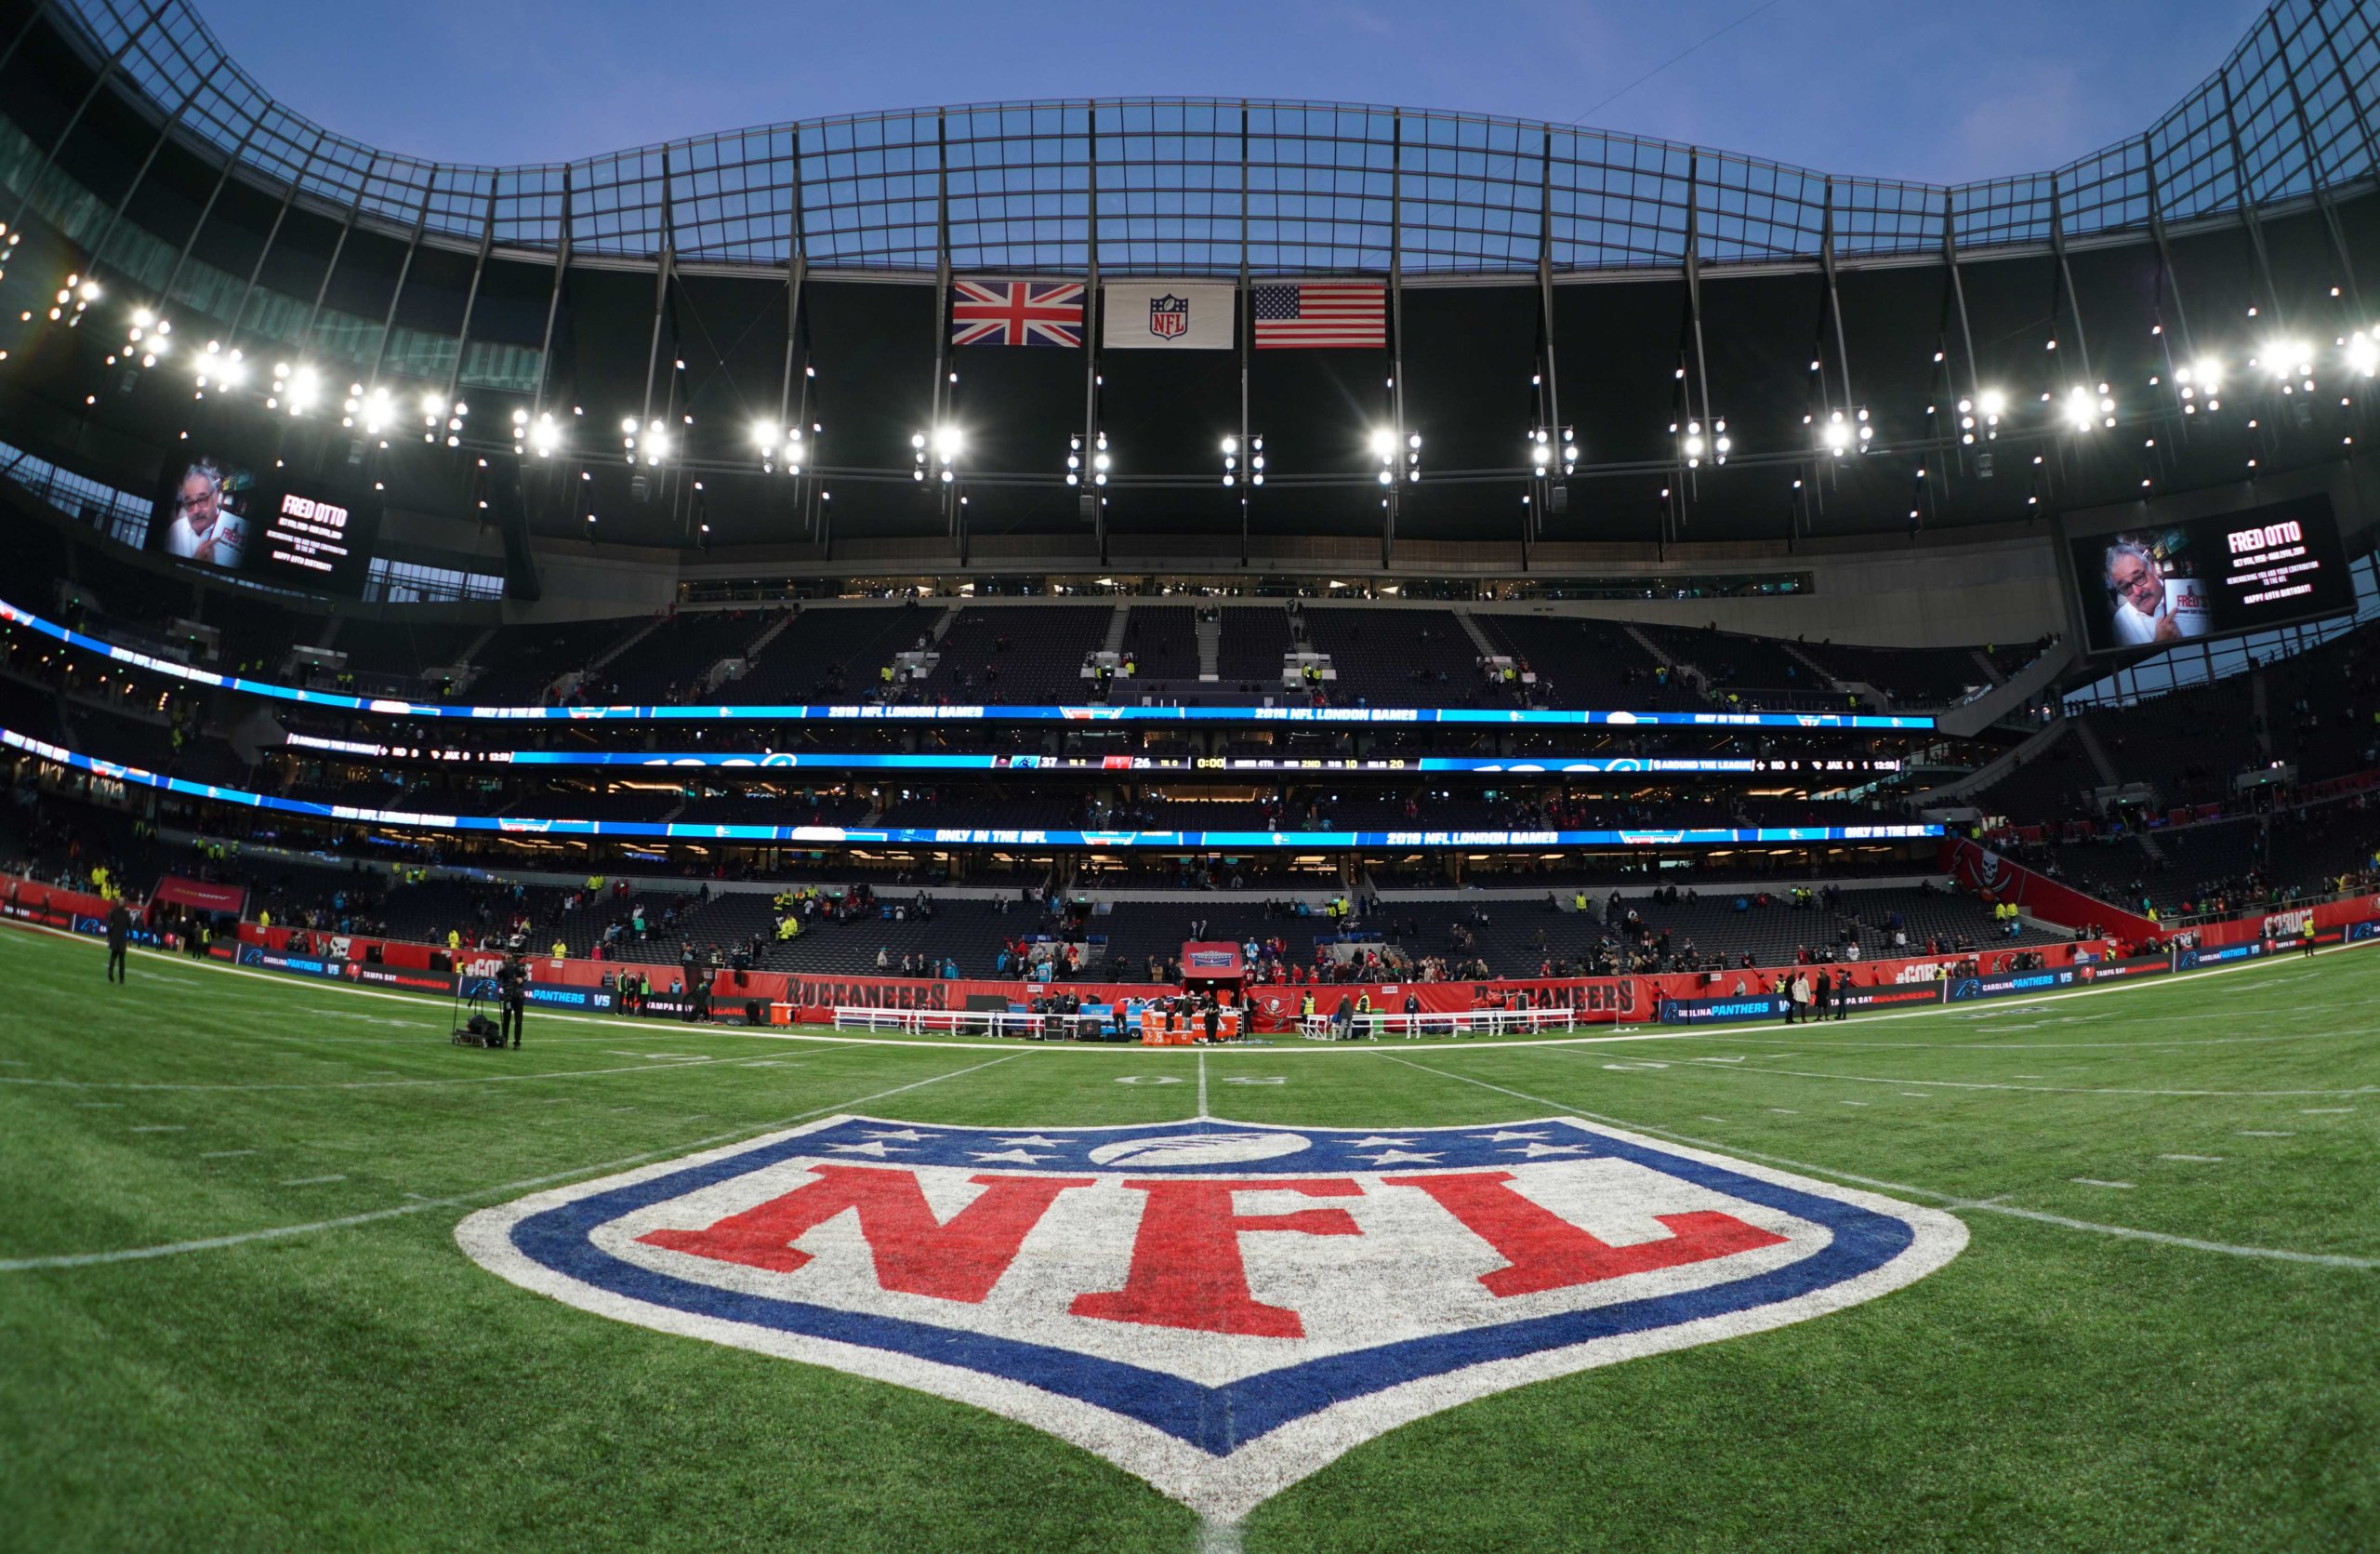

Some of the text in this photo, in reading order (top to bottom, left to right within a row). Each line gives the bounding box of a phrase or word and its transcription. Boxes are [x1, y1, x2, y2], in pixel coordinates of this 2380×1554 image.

[1153, 312, 1184, 335] NFL
[282, 494, 348, 527] FRED OTTO
[2228, 521, 2302, 553] FRED OTTO
[828, 707, 985, 718] 2019 NFL LONDON GAMES
[1255, 708, 1417, 721] 2019 NFL LONDON GAMES
[1041, 757, 1058, 767] 37
[1134, 757, 1151, 768] 26
[1197, 757, 1224, 768] 0:00
[1302, 760, 1321, 768] 2ND
[1345, 760, 1357, 769] 10
[1389, 760, 1405, 769] 20
[1661, 761, 1752, 770] AROUND THE LEAGUE
[1770, 761, 1786, 770] NO
[1827, 761, 1844, 770] JAX
[936, 830, 1047, 843] ONLY IN THE NFL
[1386, 831, 1558, 844] 2019 NFL LONDON GAMES
[1886, 825, 1906, 837] THE
[2219, 948, 2247, 960] PANTHERS
[2251, 945, 2259, 954] VS
[263, 955, 339, 976] CAROLINA PANTHERS VS
[363, 971, 397, 982] TAMPA BAY
[2096, 968, 2115, 977] TAMPA
[1982, 972, 2072, 991] CAROLINA PANTHERS VS
[533, 989, 585, 1004] PANTHERS
[594, 994, 611, 1007] VS
[787, 977, 948, 1010] BUCCANEERS
[1831, 997, 1857, 1006] TAPA
[1858, 995, 1873, 1003] BAY
[1712, 1002, 1769, 1016] PANTHERS
[637, 1162, 1788, 1339] NFL
